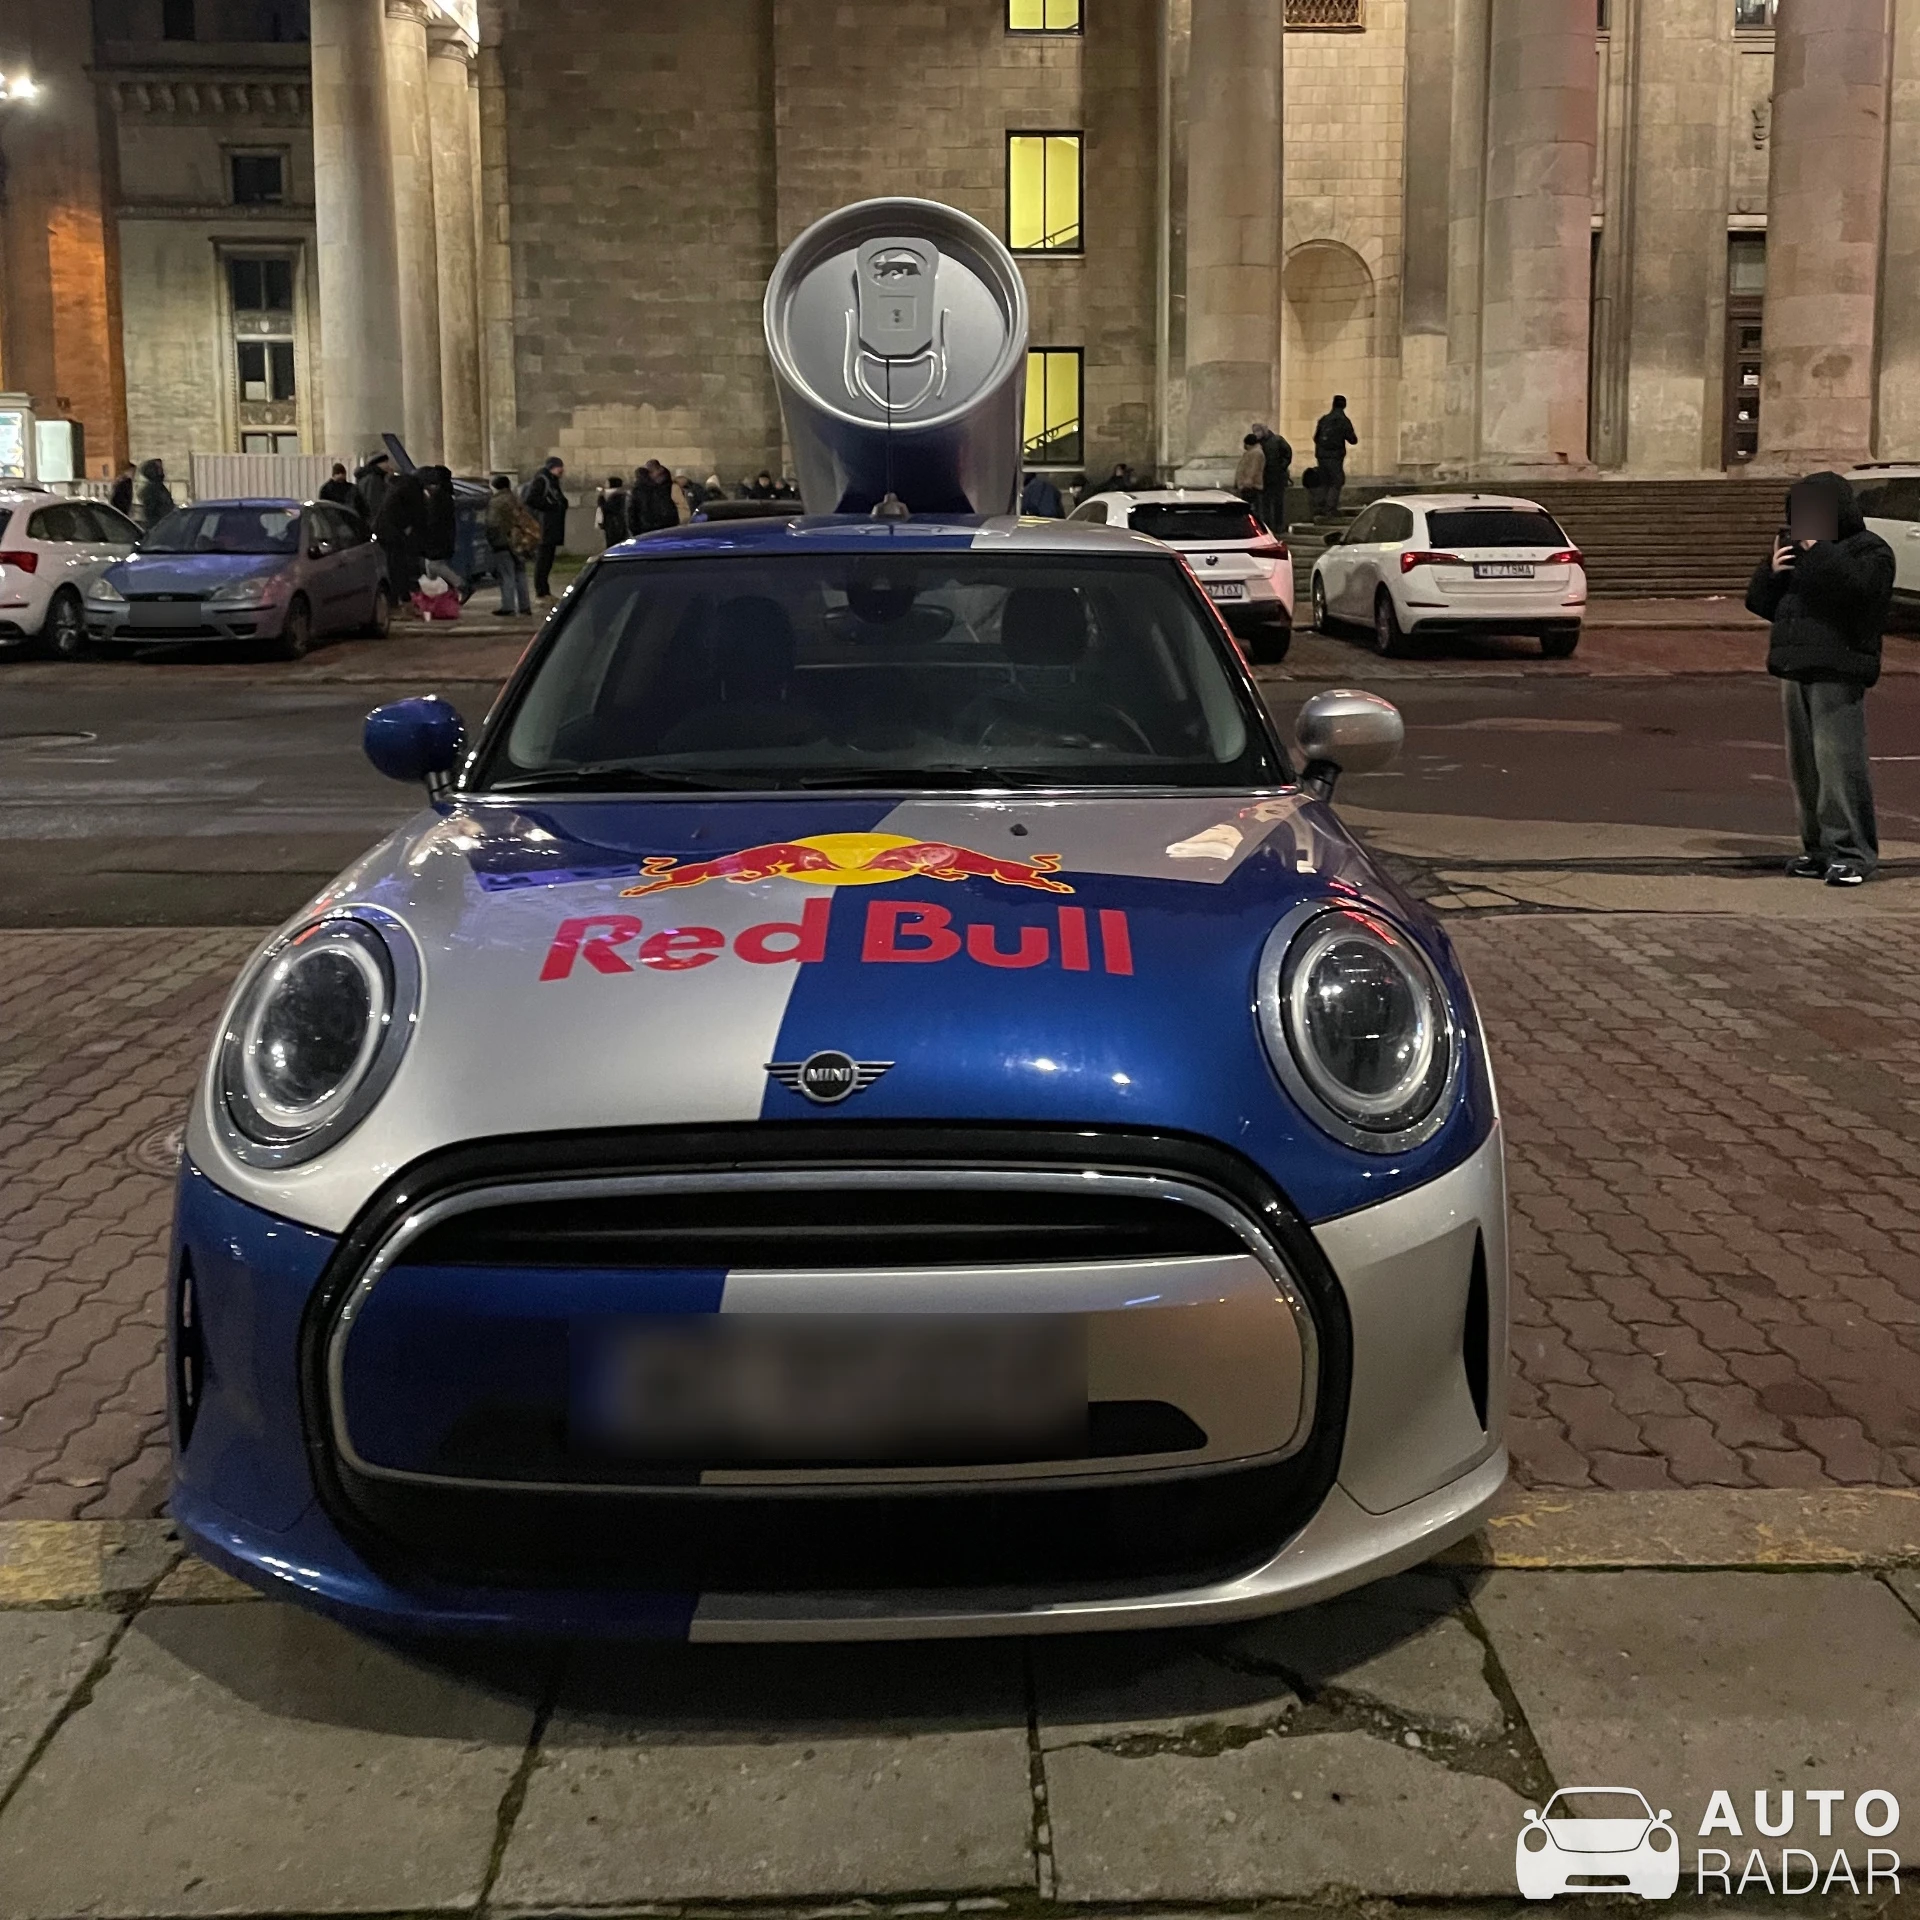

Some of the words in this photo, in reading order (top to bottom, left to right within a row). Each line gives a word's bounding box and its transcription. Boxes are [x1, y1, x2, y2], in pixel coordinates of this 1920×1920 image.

[540, 898, 832, 981] Red
[862, 900, 1134, 975] Bull
[806, 1068, 850, 1081] MINI
